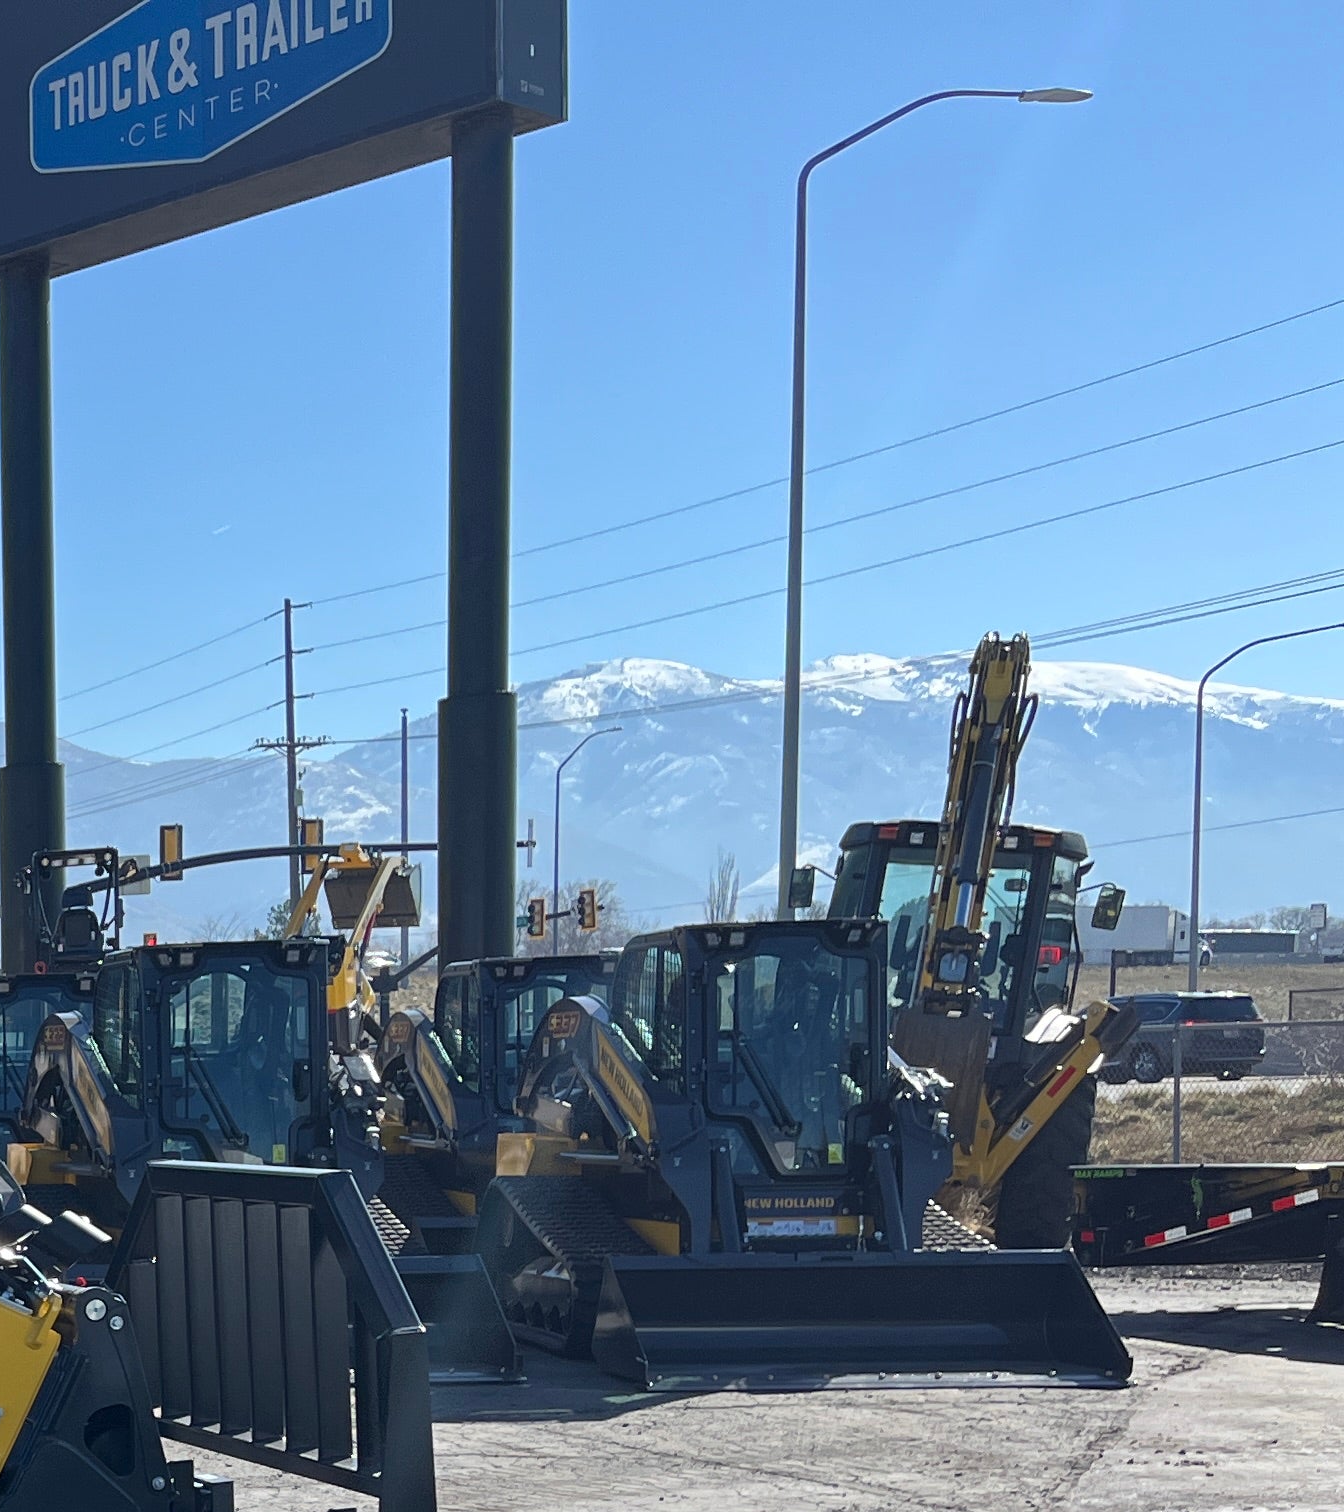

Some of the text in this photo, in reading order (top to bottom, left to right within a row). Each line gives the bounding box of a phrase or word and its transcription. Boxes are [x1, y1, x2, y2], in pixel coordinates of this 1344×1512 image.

[48, 38, 161, 131] TRUCK
[167, 27, 199, 95] &
[127, 79, 271, 147] CENTER
[744, 1197, 835, 1209] NEW HOLLAND
